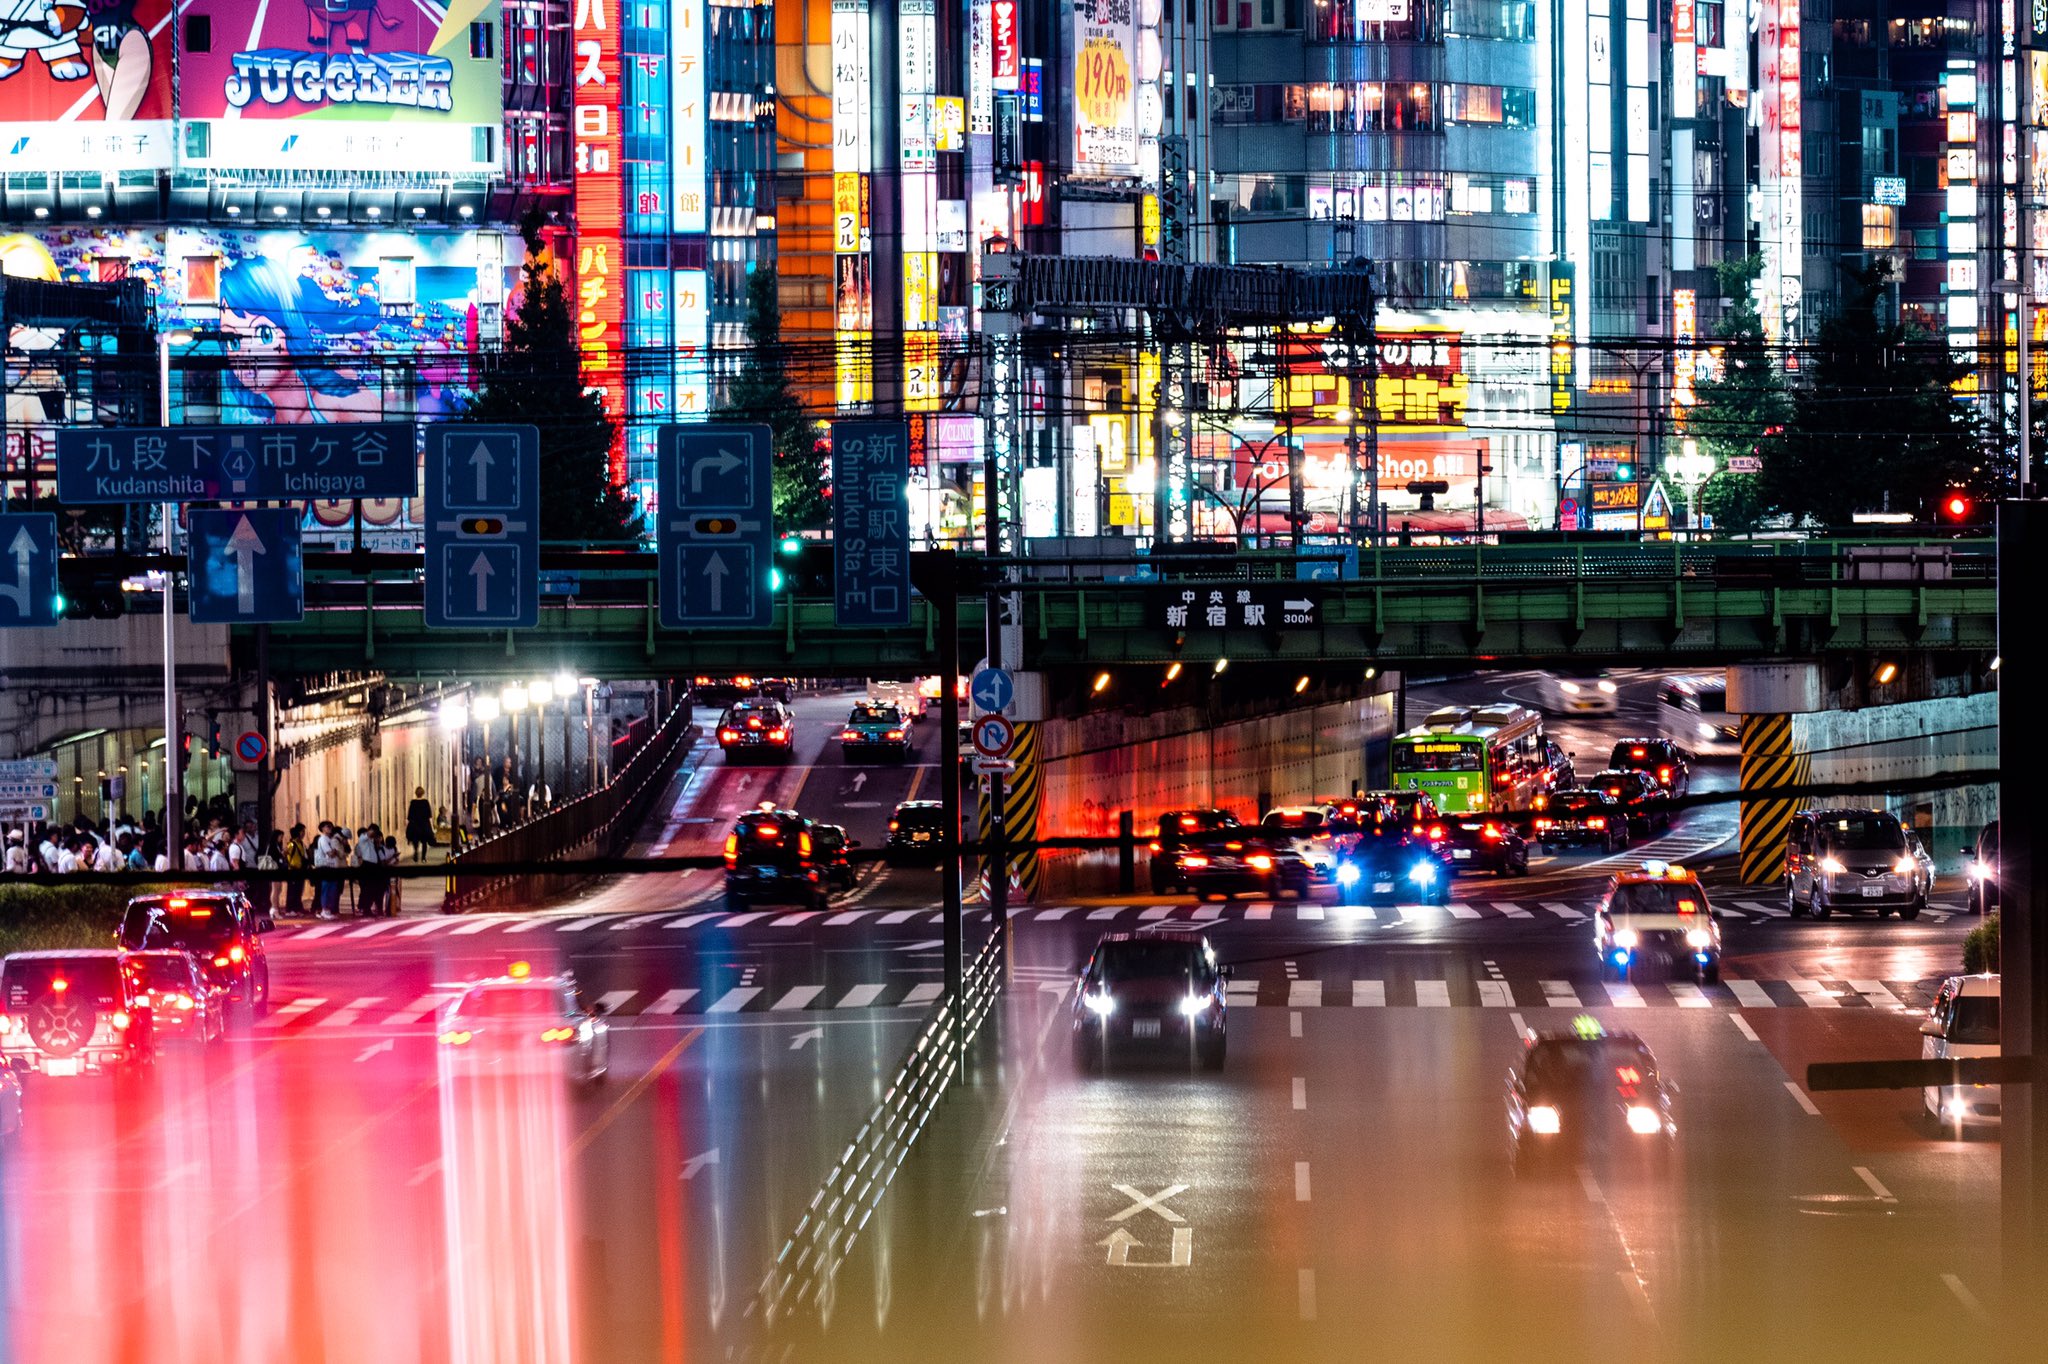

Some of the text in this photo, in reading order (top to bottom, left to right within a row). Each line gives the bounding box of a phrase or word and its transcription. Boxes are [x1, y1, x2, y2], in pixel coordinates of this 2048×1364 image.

[997, 18, 1013, 76] アイフル
[224, 50, 454, 111] JUGGLER
[836, 29, 856, 147] 小松ビル
[579, 243, 608, 371] パチンコ
[86, 435, 214, 472] 九段下
[231, 460, 246, 475] 4
[96, 474, 206, 497] Kudanshita
[284, 471, 366, 492] Ichigaya
[841, 439, 865, 529] Shinjuku
[867, 433, 900, 613] 新宿駅東口
[340, 539, 411, 550] 新大ガード西
[1181, 590, 1252, 605] 中央線
[1166, 604, 1266, 628] 新宿駅
[1283, 613, 1314, 625] 300M
